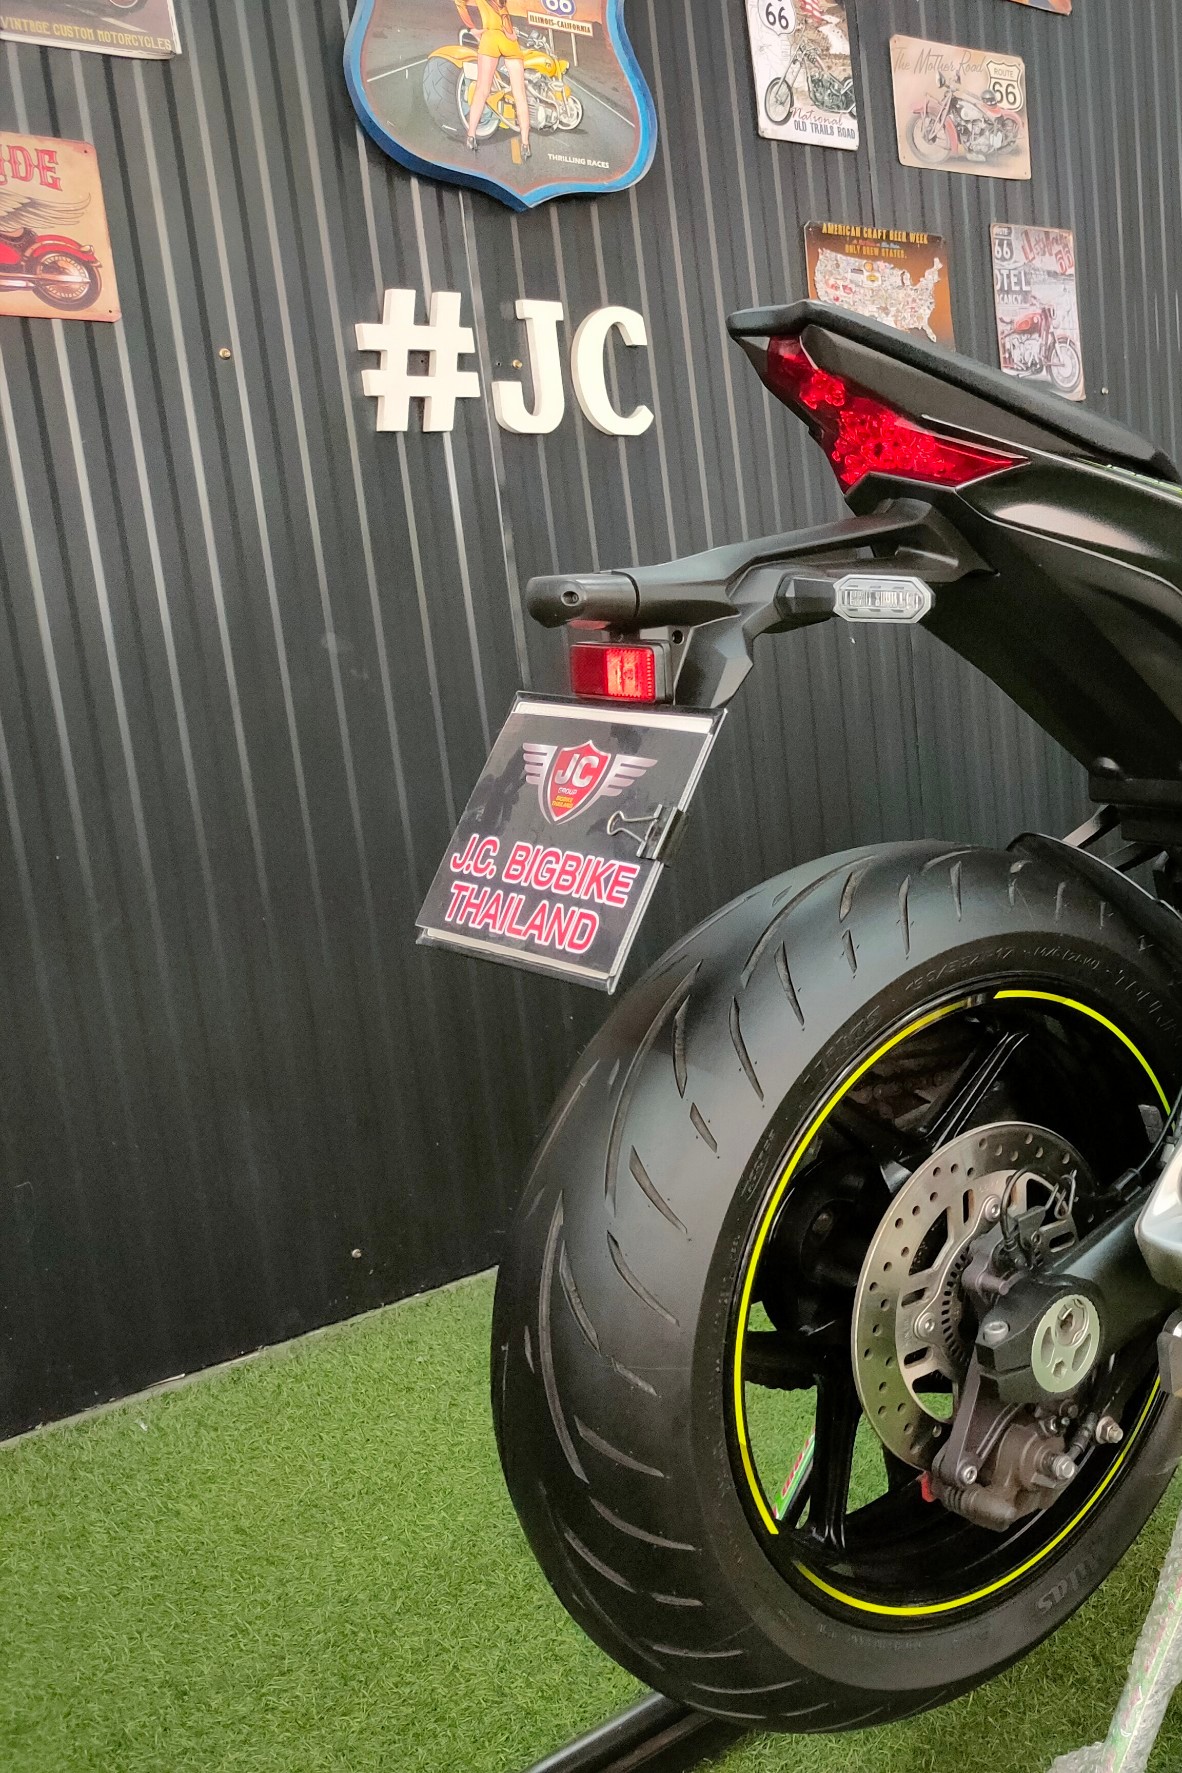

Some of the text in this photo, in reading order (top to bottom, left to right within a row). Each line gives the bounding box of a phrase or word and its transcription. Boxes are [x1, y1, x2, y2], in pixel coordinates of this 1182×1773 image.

[765, 2, 789, 30] 66
[0, 16, 172, 50] VINTAGE CUSTOM MOTORCYCLES
[893, 47, 986, 76] The Mother Road
[993, 67, 1014, 78] ROUTE
[993, 81, 1017, 106] 66
[790, 107, 843, 126] National
[794, 120, 855, 139] OLD TRAILS ROAD
[547, 153, 609, 169] THRILLING RACES
[822, 223, 861, 237] AMERICAN
[863, 226, 887, 240] CRAFT
[890, 230, 907, 243] BEER
[909, 232, 928, 245] WEEK
[995, 239, 1011, 260] 66
[554, 753, 600, 788] JC
[450, 833, 640, 908] J.C. BIGBIKE
[445, 881, 599, 954] THAILAND
